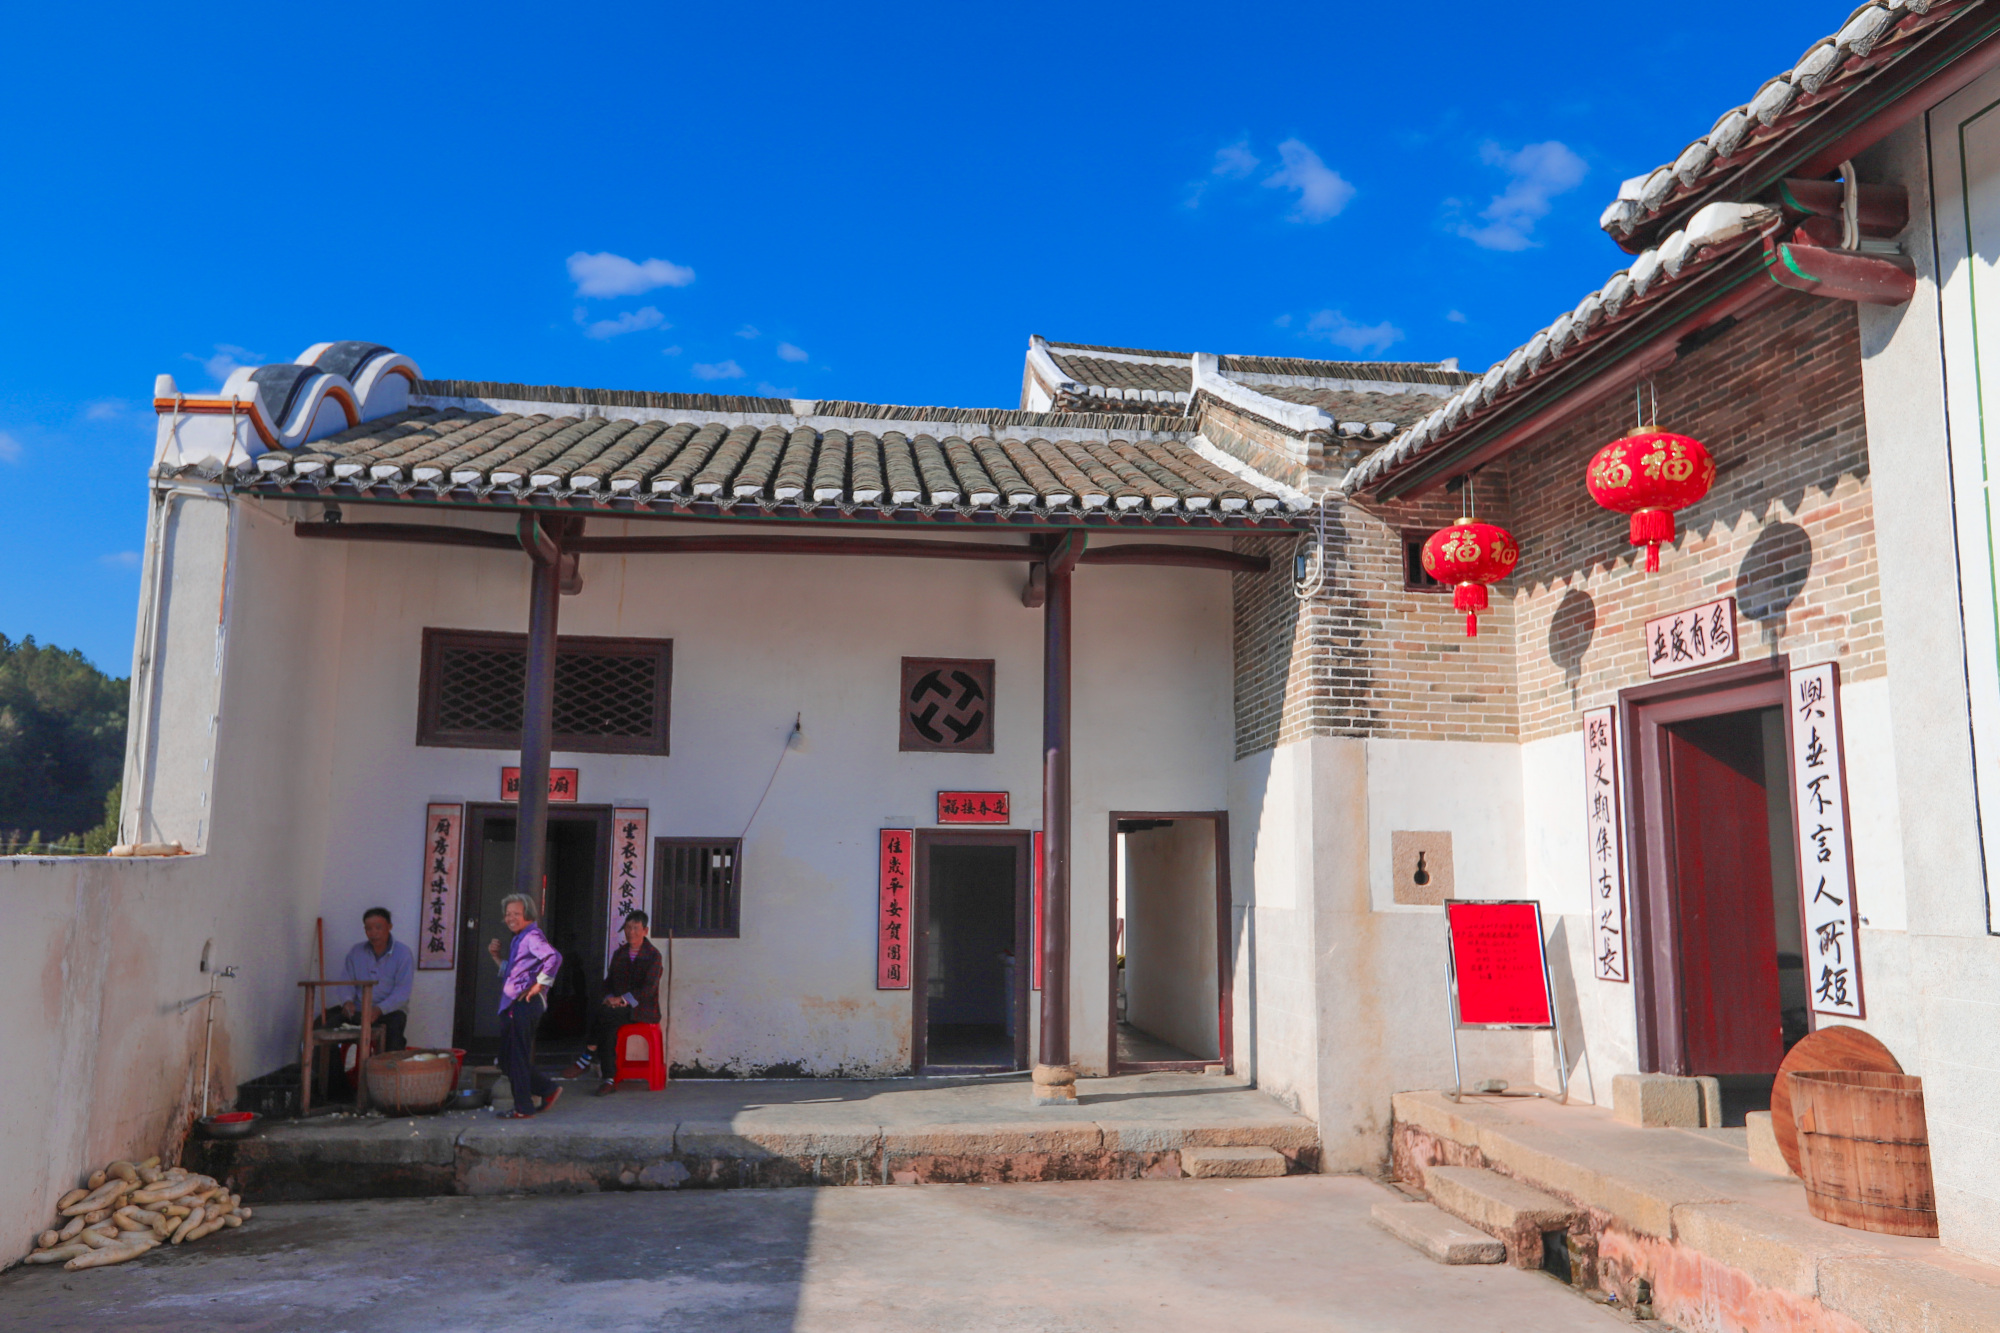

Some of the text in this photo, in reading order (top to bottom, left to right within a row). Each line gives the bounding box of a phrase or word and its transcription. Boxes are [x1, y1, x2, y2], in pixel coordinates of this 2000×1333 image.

[1592, 446, 1632, 490] 福
[1640, 439, 1694, 482] 福
[1440, 529, 1482, 563] 福
